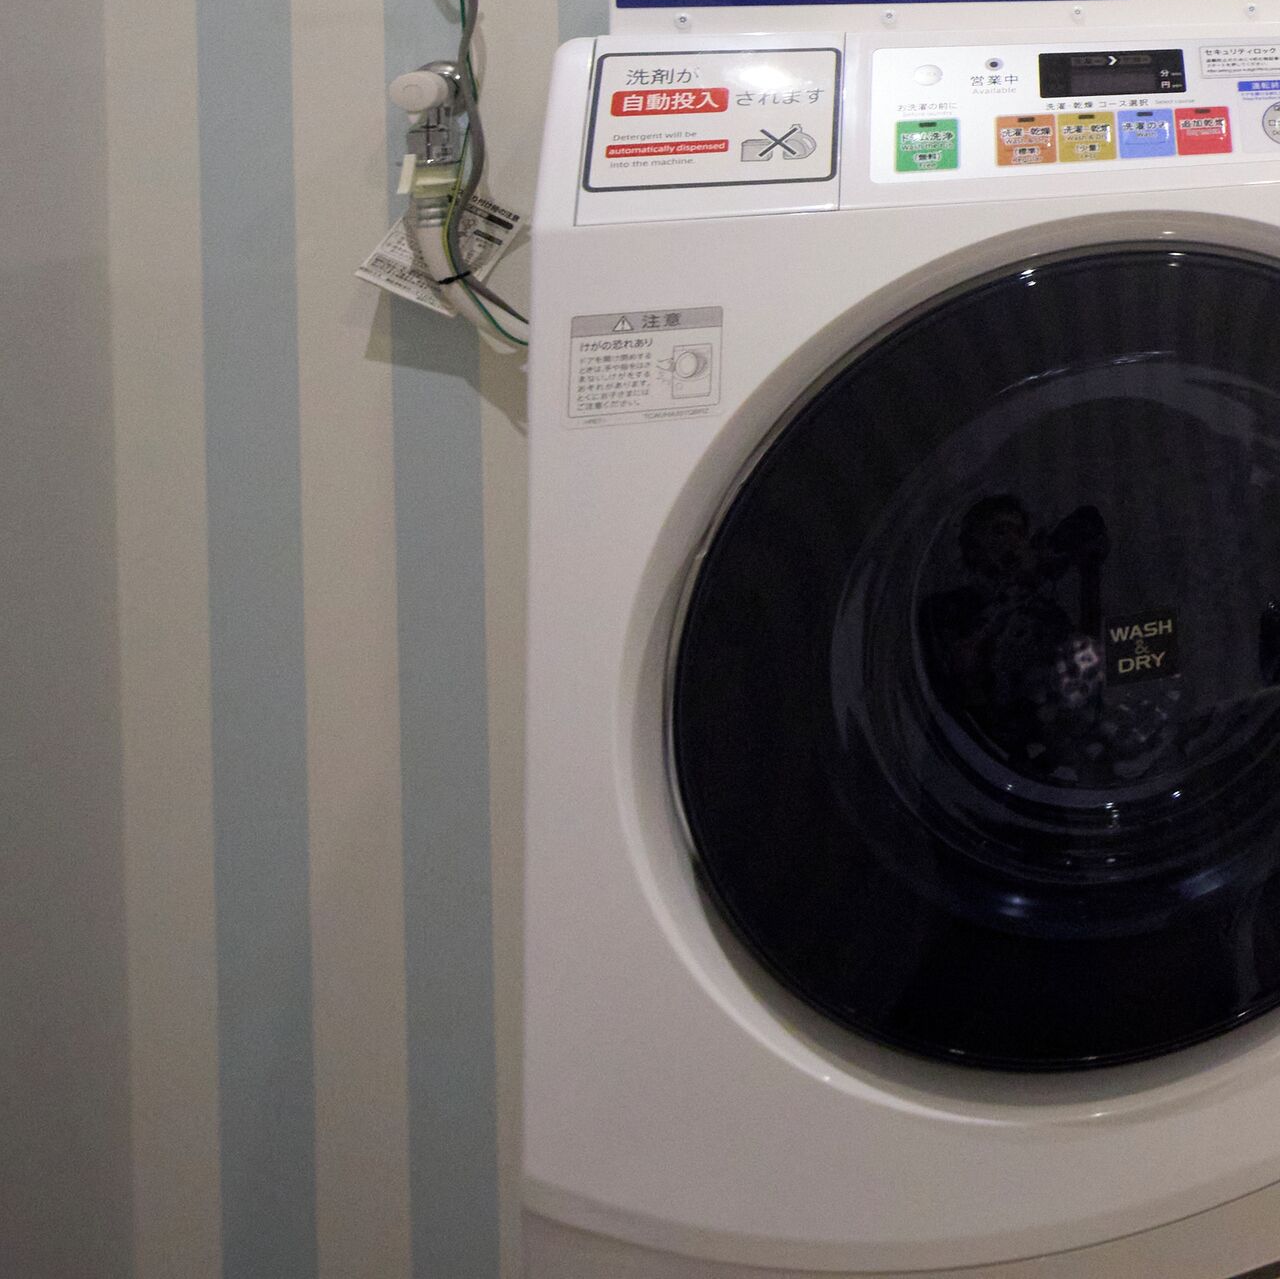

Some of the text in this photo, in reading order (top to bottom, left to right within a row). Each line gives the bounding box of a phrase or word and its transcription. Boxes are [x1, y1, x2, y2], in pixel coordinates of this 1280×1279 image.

[625, 66, 701, 86] 洗剤が
[970, 74, 1019, 87] 営業中
[622, 91, 720, 112] 自動投入
[736, 87, 825, 107] されます
[613, 130, 697, 143] Detergent will be
[608, 141, 726, 156] automatically dispensed
[610, 160, 630, 169] into
[632, 159, 649, 168] the
[641, 312, 682, 328] 注意
[579, 338, 653, 352] けがの恐れあり
[1109, 619, 1173, 643] WASH
[1118, 651, 1167, 674] DRY
